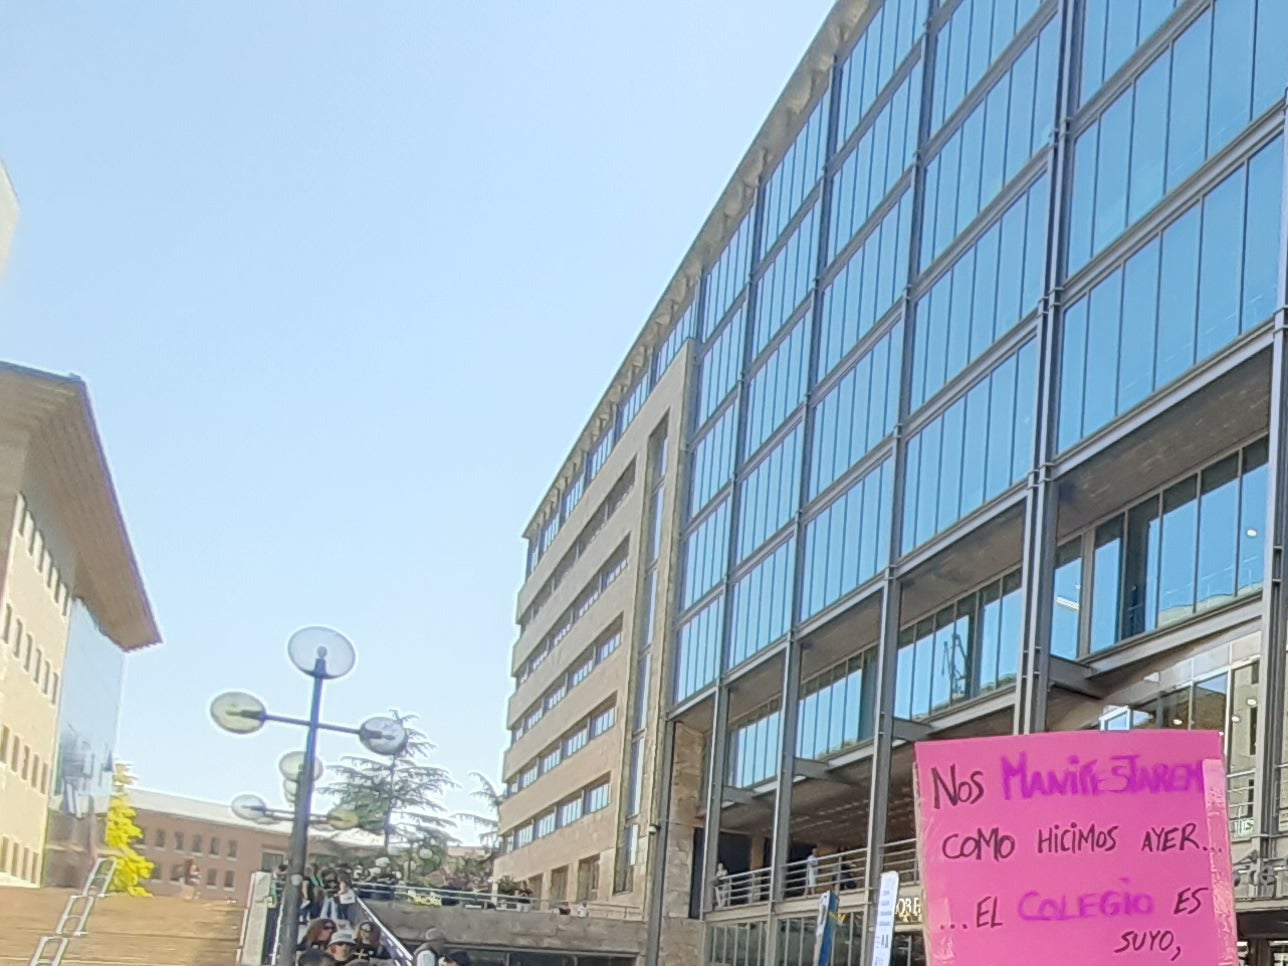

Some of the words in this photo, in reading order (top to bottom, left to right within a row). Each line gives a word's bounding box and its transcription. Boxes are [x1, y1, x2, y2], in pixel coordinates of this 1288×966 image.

[941, 827, 1016, 862] COMO
[1173, 886, 1209, 916] ES
[1114, 929, 1182, 961] SUYO,
